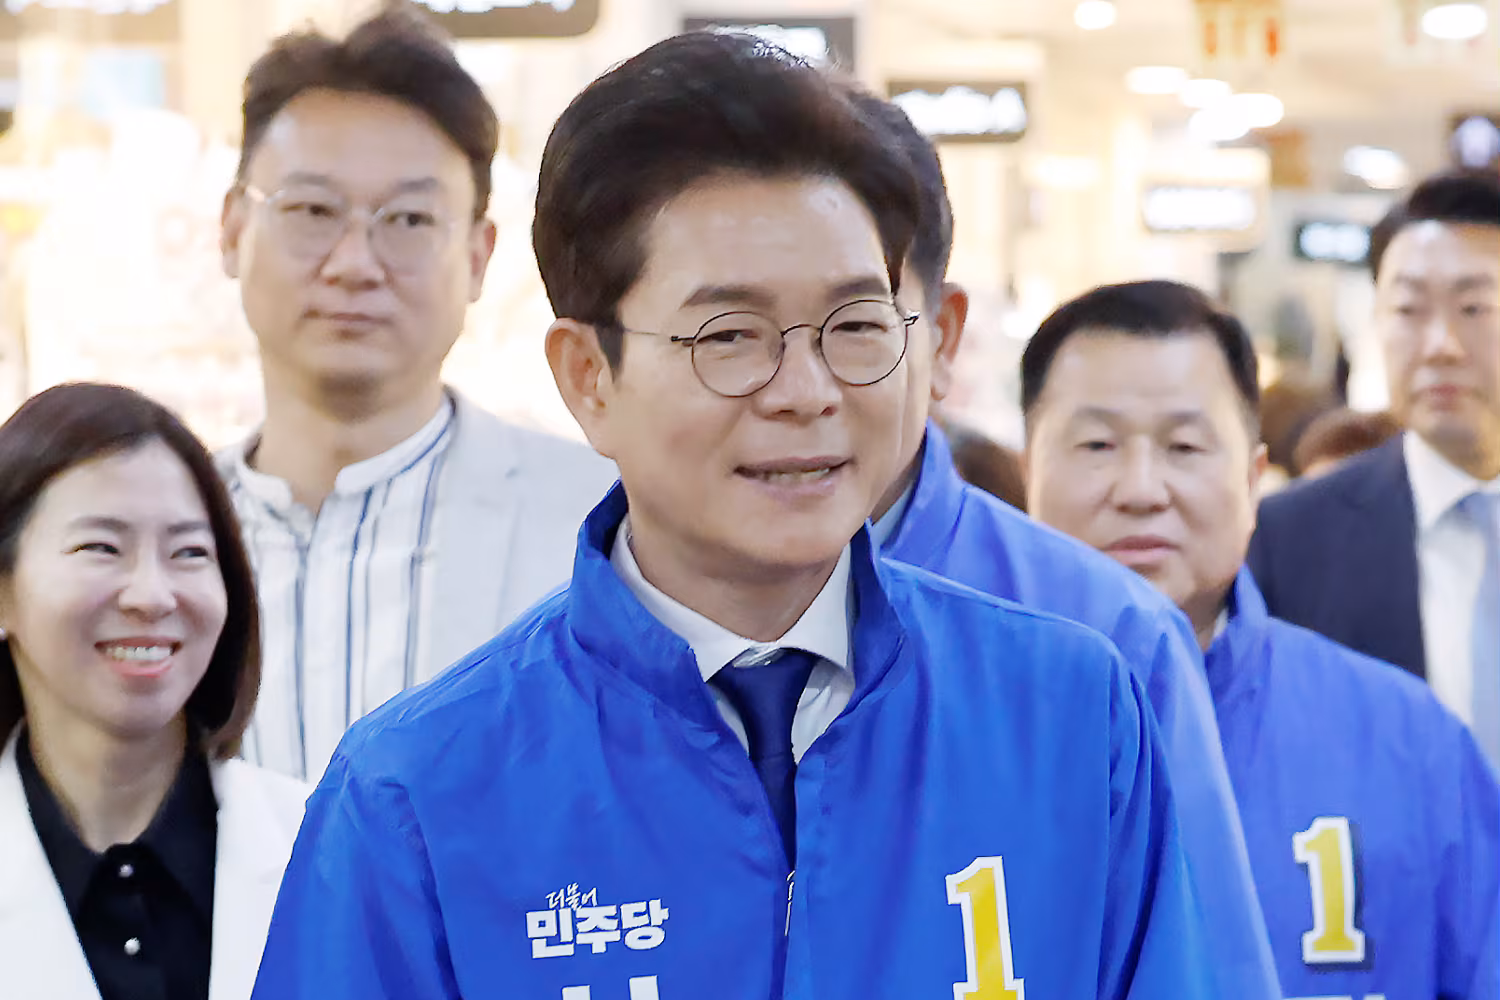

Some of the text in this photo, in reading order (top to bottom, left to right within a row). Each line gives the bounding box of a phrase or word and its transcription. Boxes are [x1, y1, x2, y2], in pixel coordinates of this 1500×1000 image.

[545, 882, 598, 911] 더불어
[1293, 816, 1365, 963] 1
[526, 898, 669, 959] 민주당
